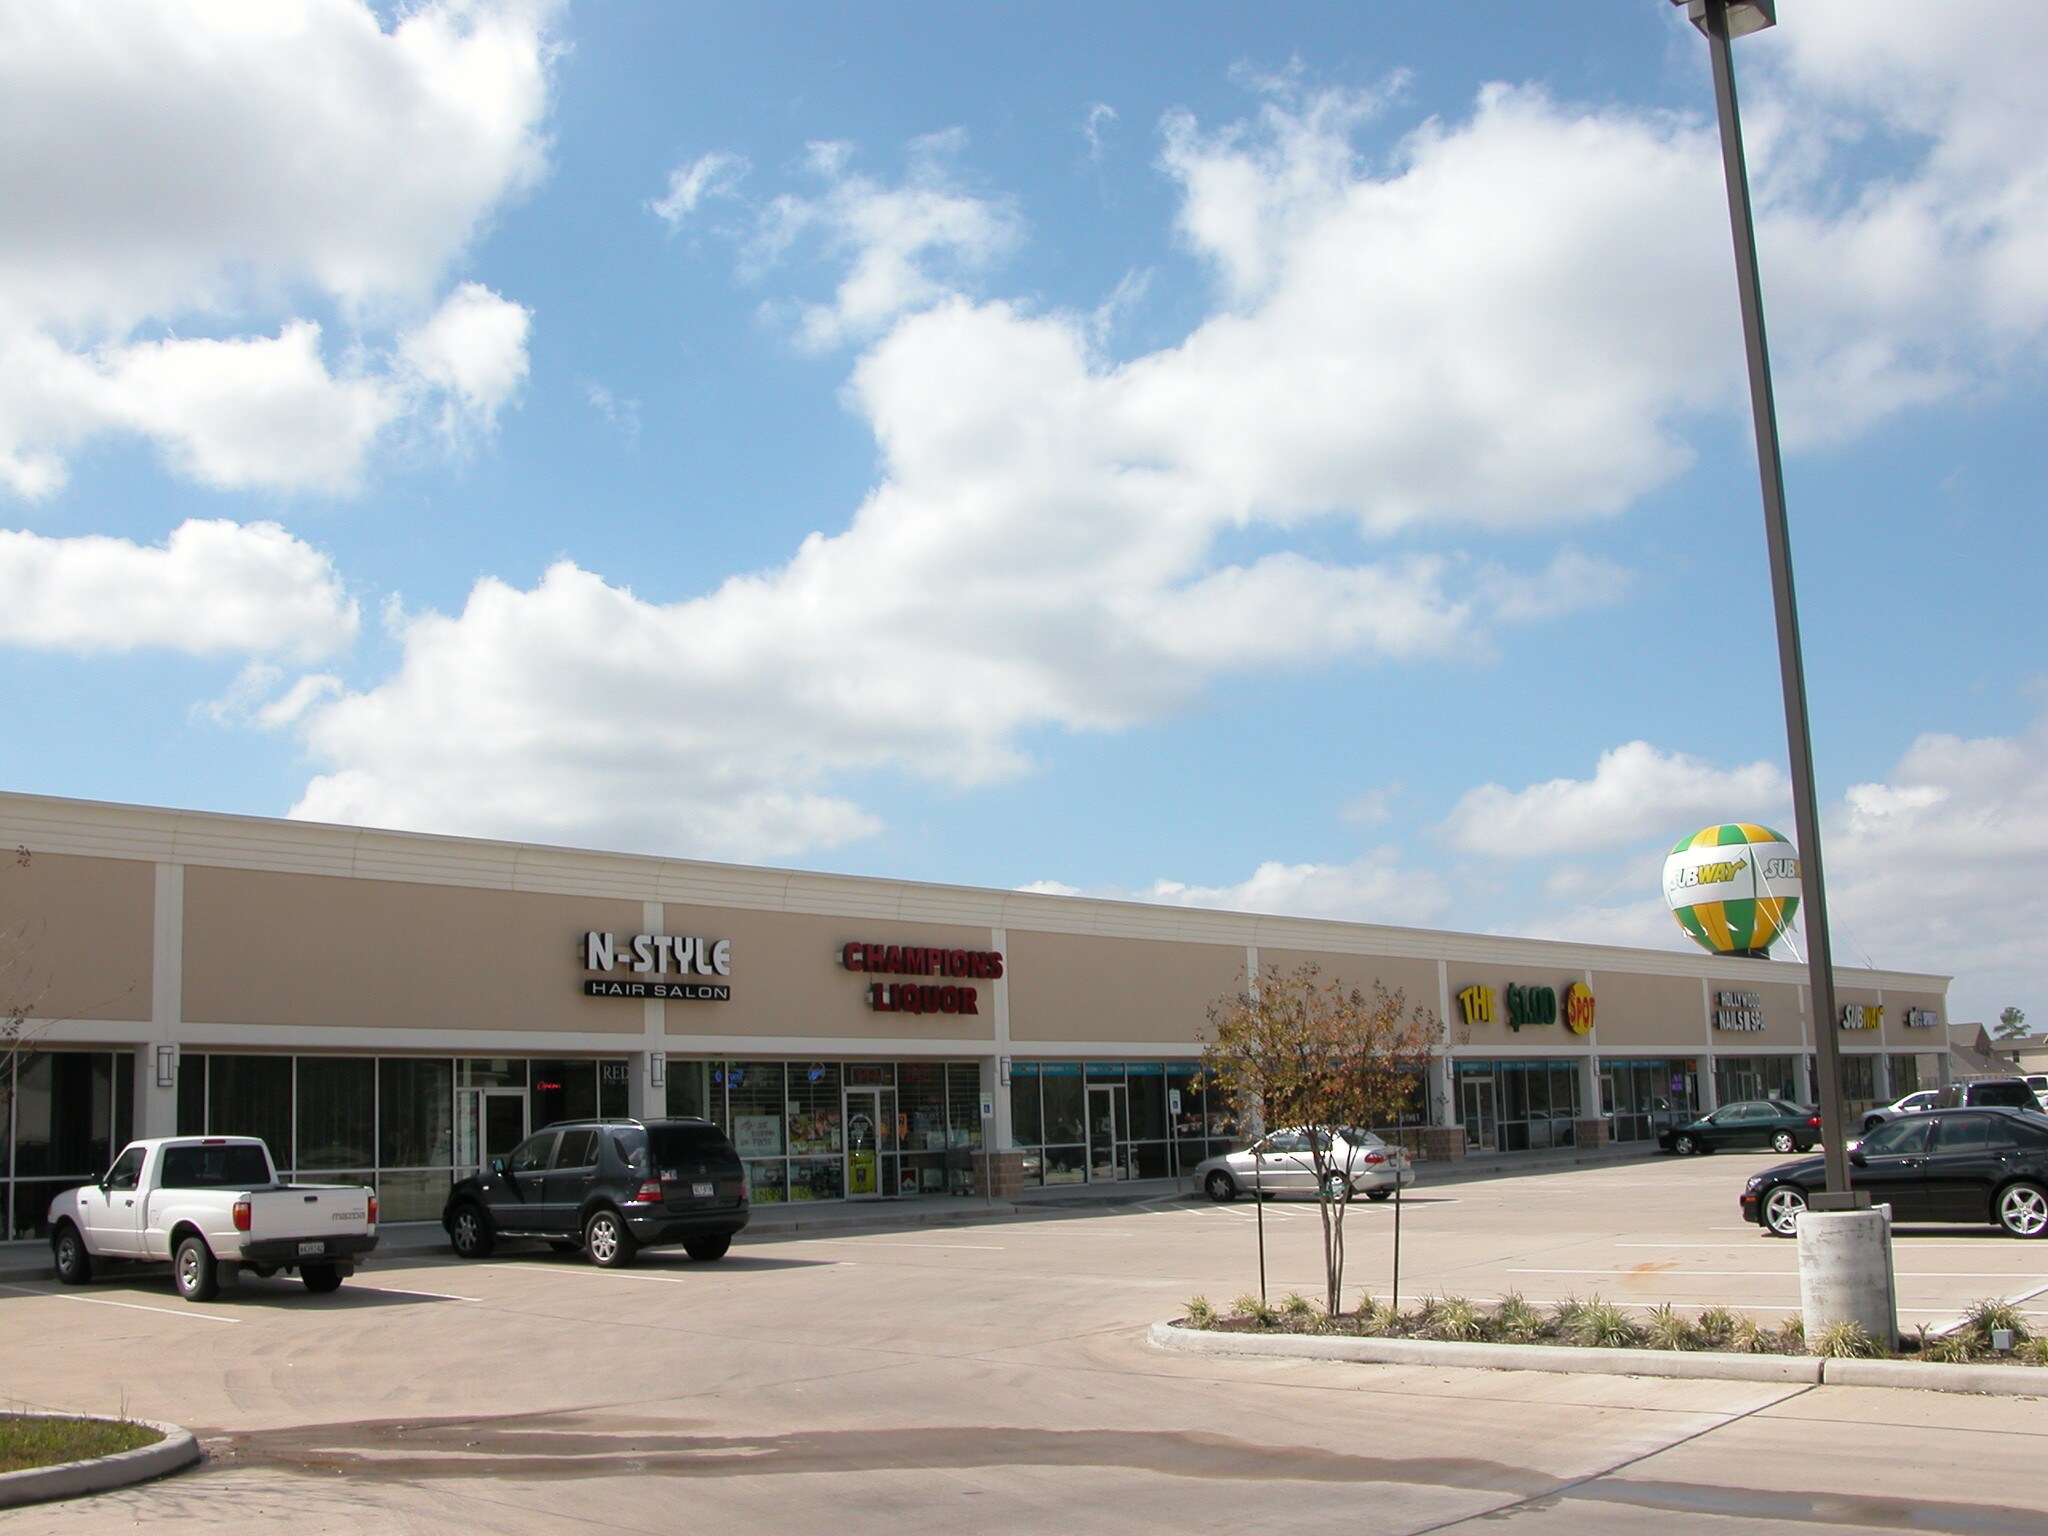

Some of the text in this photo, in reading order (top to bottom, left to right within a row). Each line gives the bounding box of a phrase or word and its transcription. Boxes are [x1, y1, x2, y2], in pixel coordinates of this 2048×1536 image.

[1670, 859, 1747, 891] SUBWAY
[585, 931, 731, 976] N-STYLE
[843, 941, 1003, 979] CHAMPIONS
[592, 982, 728, 999] HAIR SALON
[872, 982, 979, 1015] LIQUOR
[1718, 991, 1760, 1008] HOLLYWOOD
[1456, 985, 1498, 1025] THE
[1567, 986, 1596, 1028] SPOT
[1842, 1005, 1886, 1029] SUBWAY
[1717, 1010, 1744, 1031] NAILS
[1750, 1010, 1766, 1032] SPA
[332, 1211, 366, 1221] mazda
